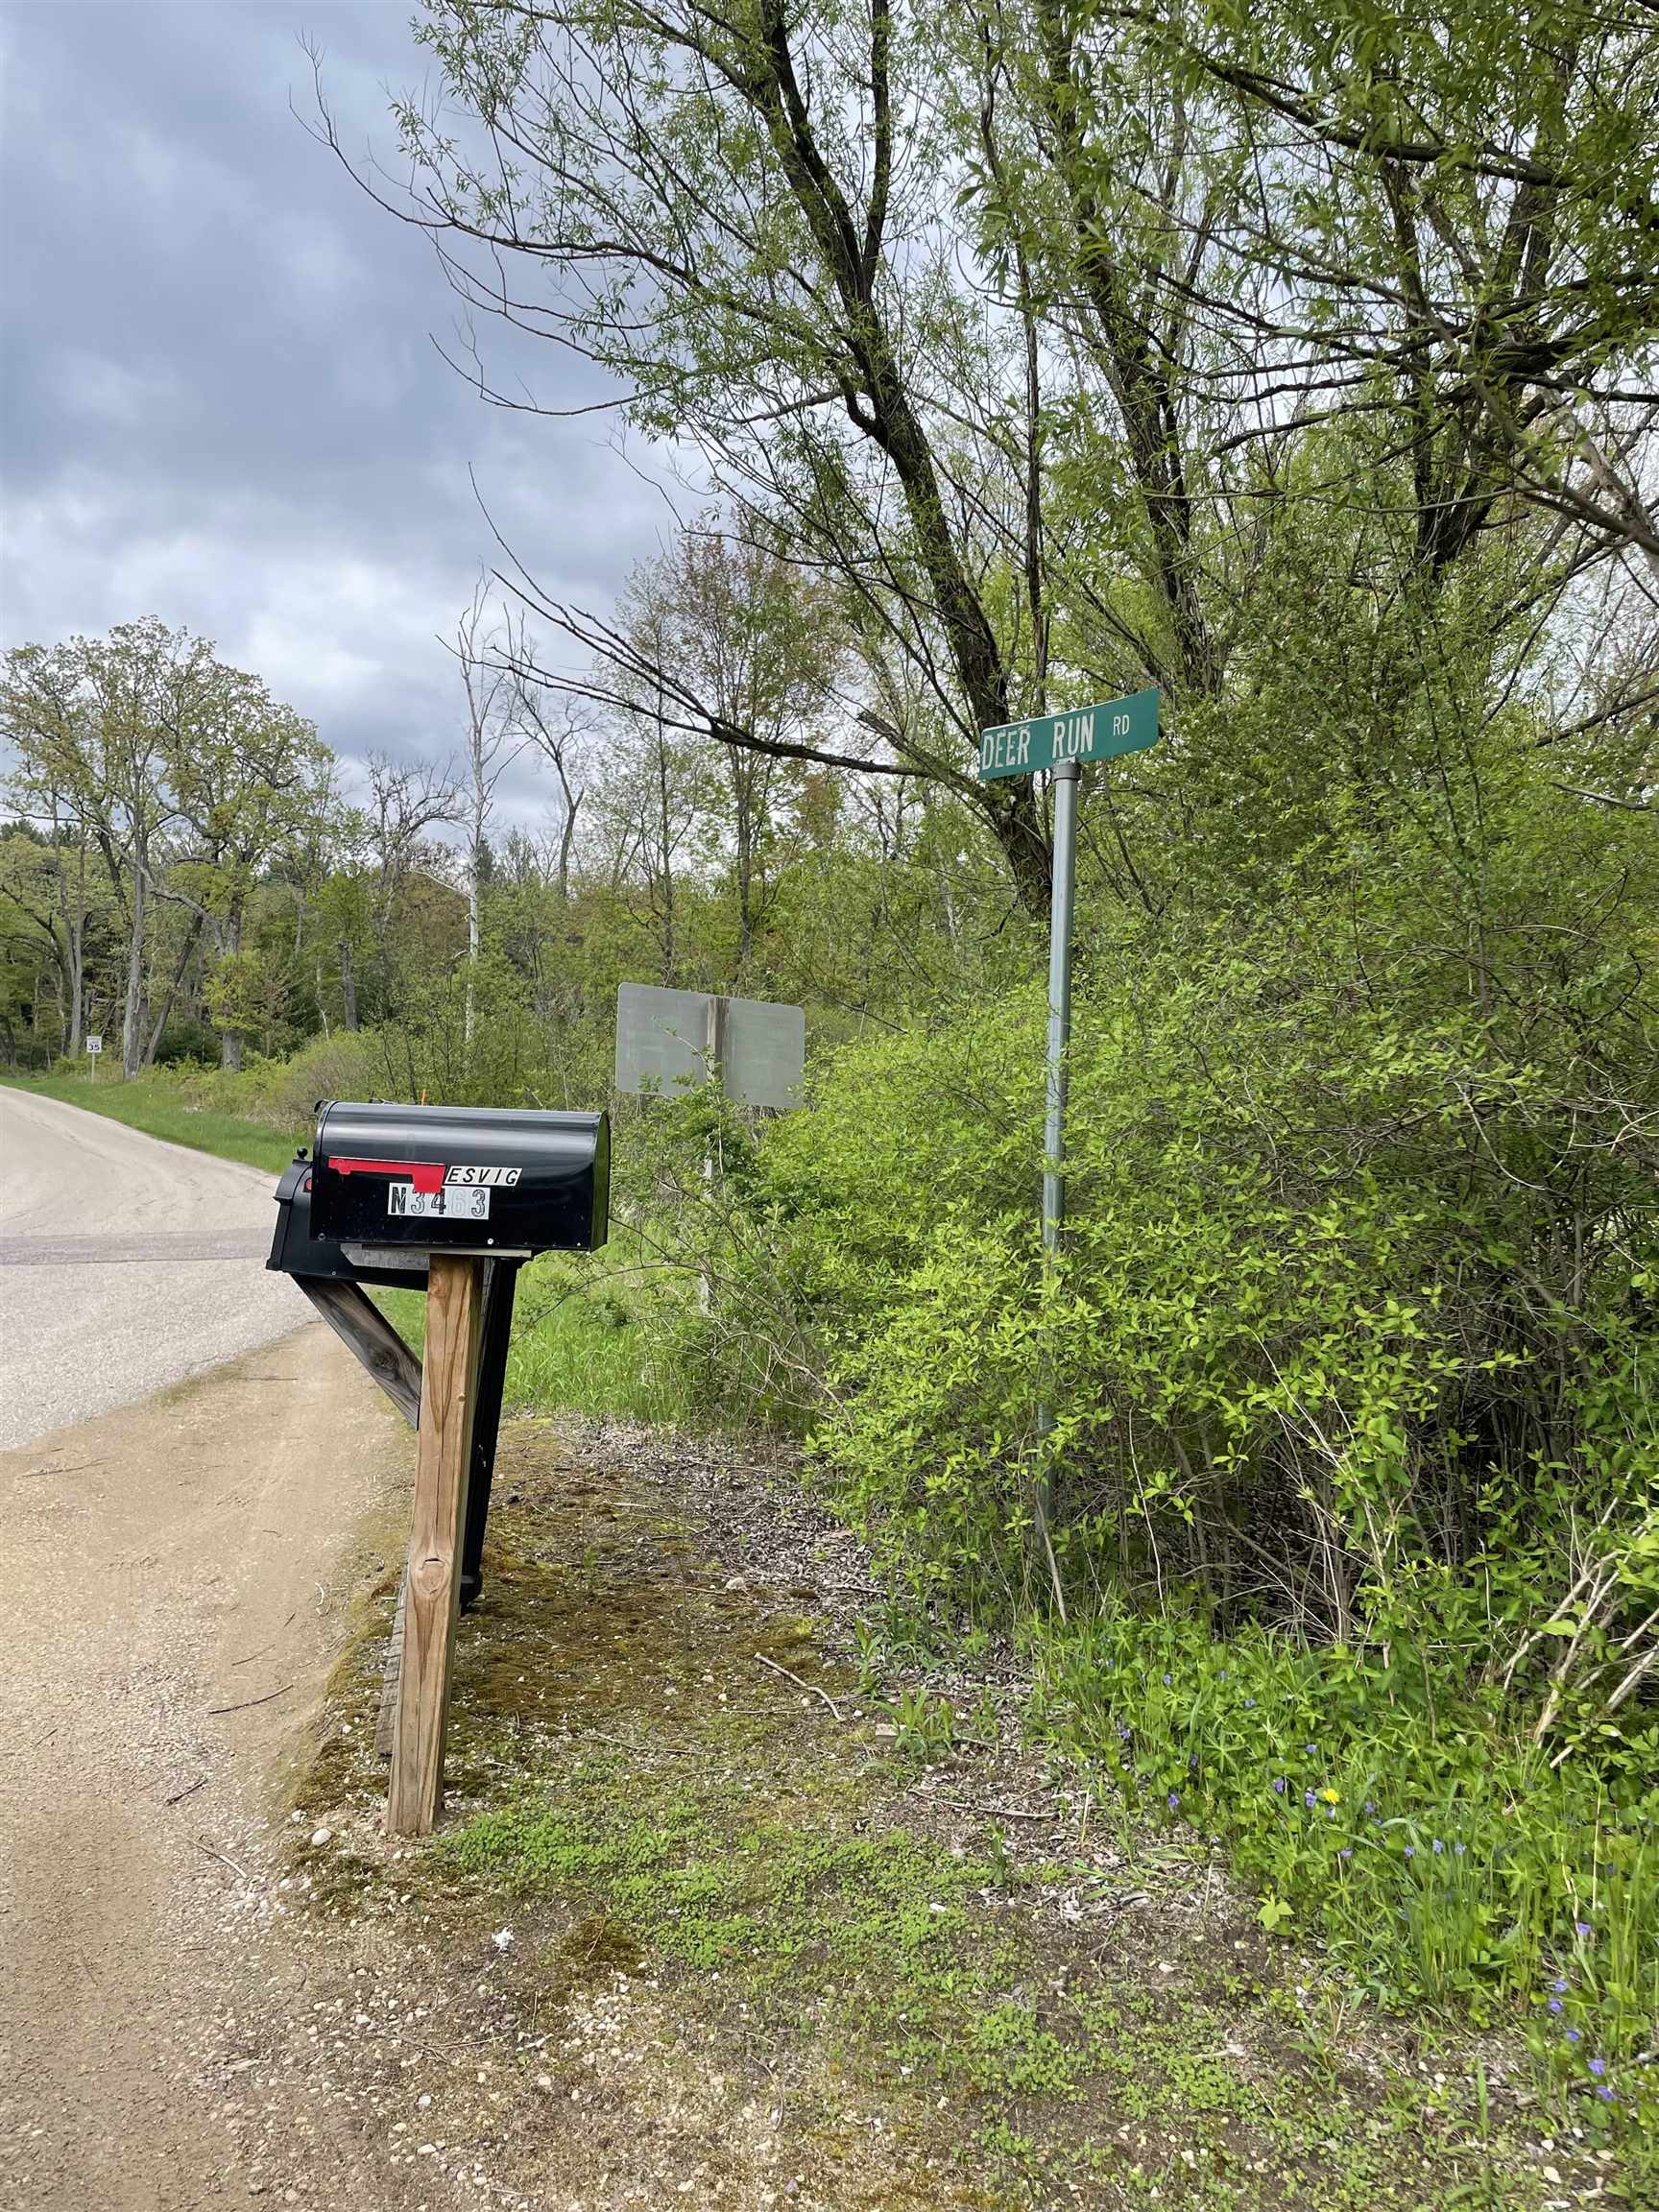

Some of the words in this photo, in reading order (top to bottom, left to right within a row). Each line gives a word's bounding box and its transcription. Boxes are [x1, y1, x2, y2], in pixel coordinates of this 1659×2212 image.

[982, 726, 1031, 770] DEER
[1052, 713, 1094, 758] RUN
[1113, 714, 1130, 736] RD
[447, 1167, 518, 1185] ESVIG
